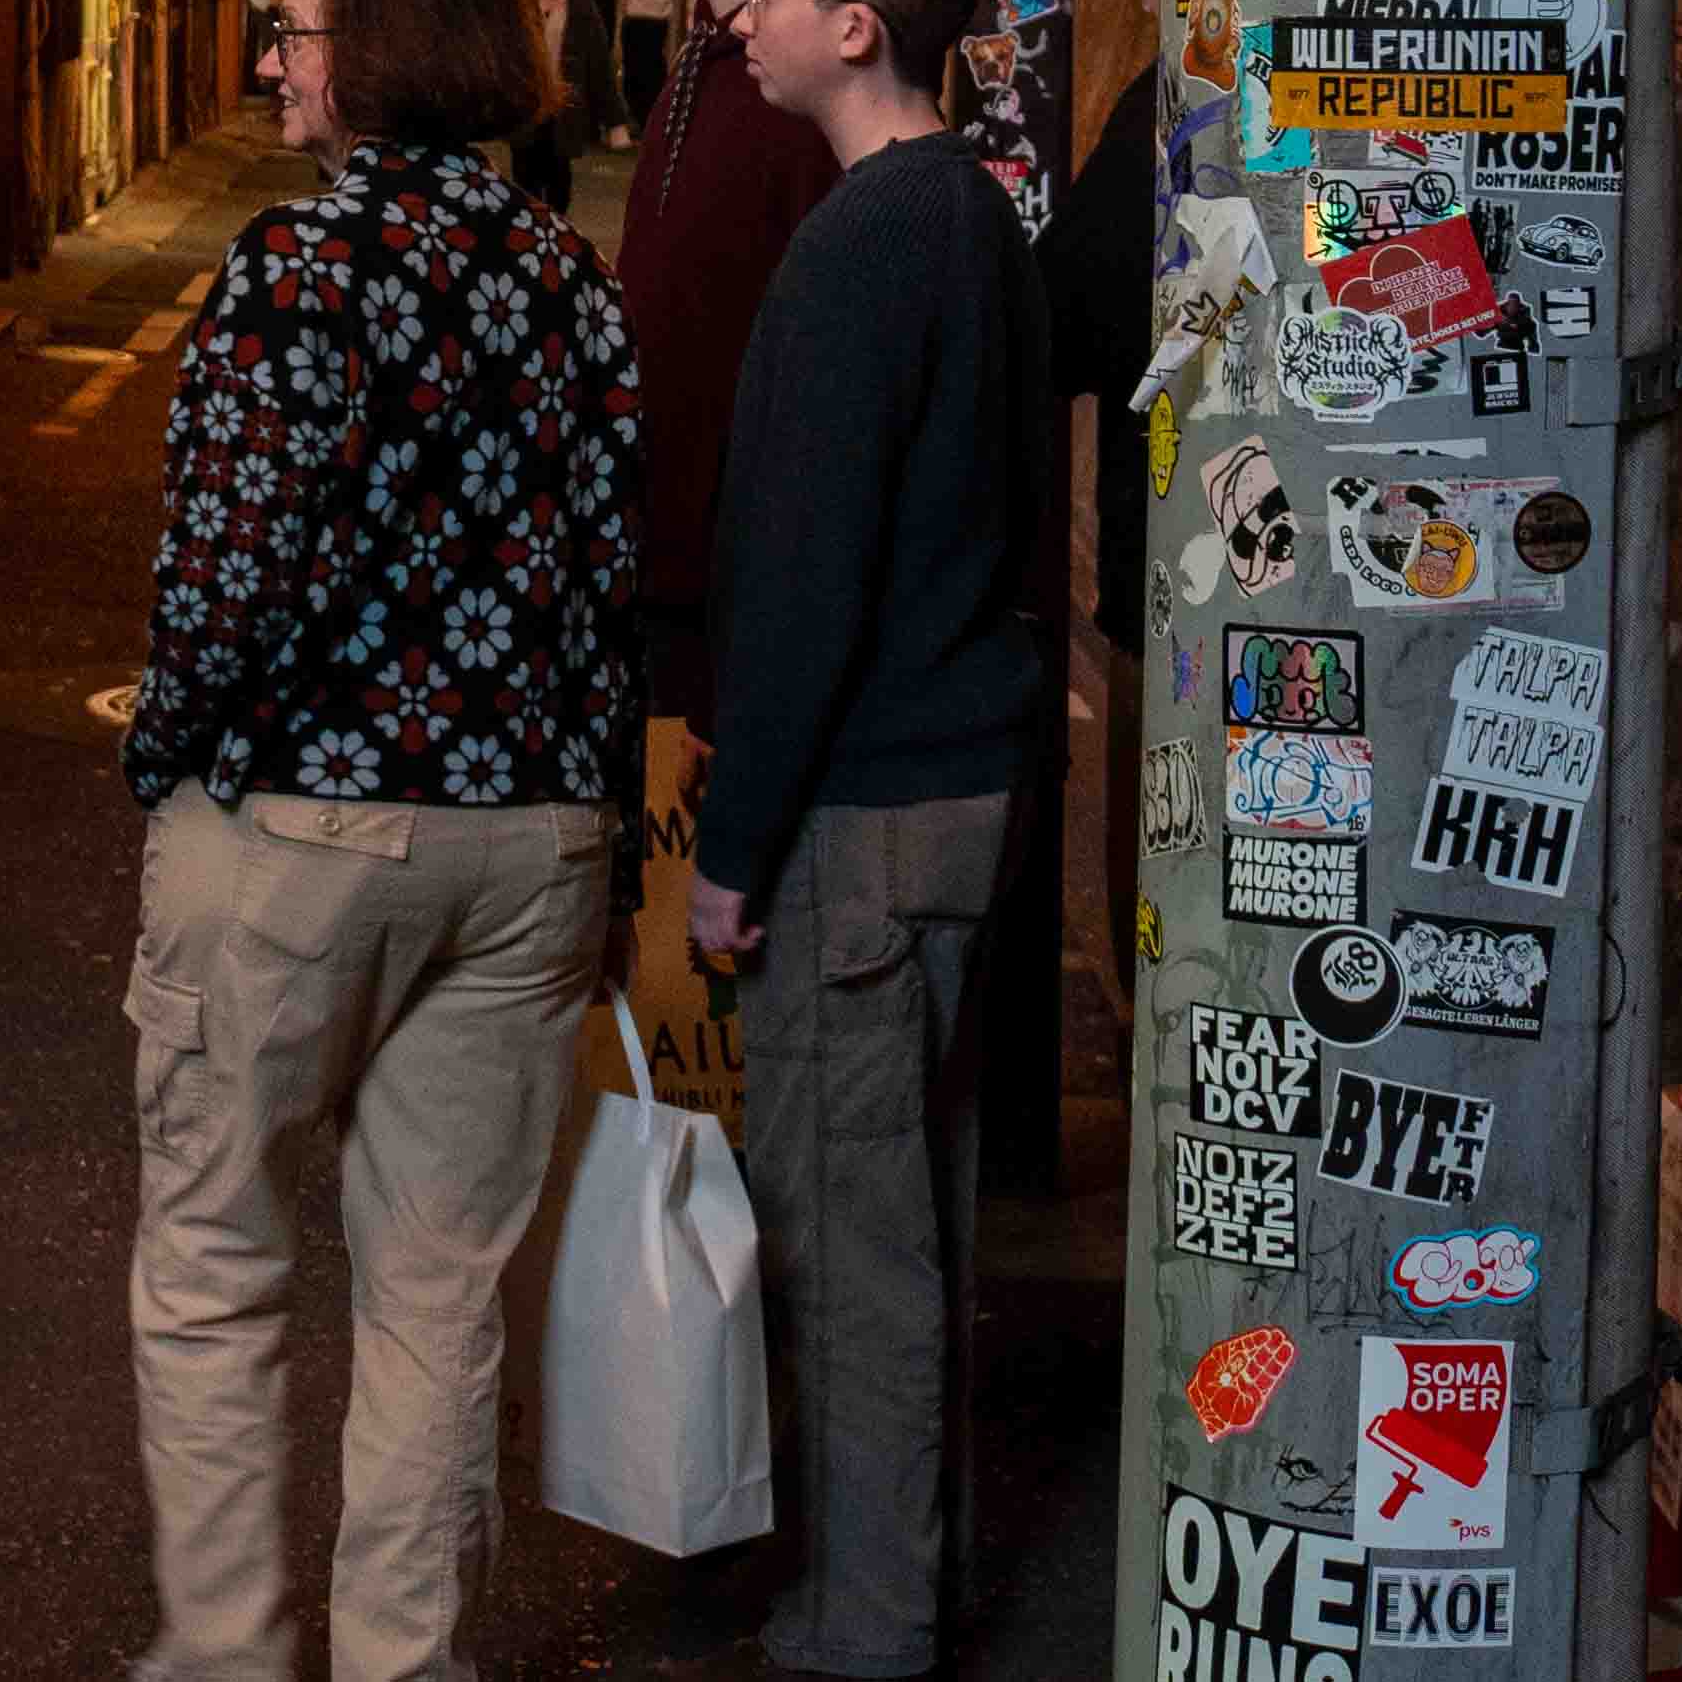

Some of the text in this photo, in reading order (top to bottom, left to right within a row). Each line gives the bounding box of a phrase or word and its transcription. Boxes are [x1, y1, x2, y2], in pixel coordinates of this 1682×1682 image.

[1292, 28, 1544, 71] WULFRUNIAN
[1318, 76, 1515, 118] REPUBLIC
[1475, 172, 1624, 193] DON'T MAKE PROMISES
[1308, 353, 1377, 381] Studio
[1474, 636, 1603, 711] TALPA
[1464, 706, 1597, 786] TALPA
[1230, 836, 1360, 871] MURONE
[1230, 861, 1360, 896] MURONE
[1230, 886, 1360, 922] MURONE
[1191, 1002, 1317, 1058] FEAR
[1457, 1011, 1495, 1026] LEBEN
[1495, 1013, 1540, 1031] LÄNGER
[1195, 1049, 1310, 1097] NOIZ
[1203, 1085, 1303, 1134] DCV
[1320, 1077, 1459, 1202] BYE
[1177, 1144, 1295, 1193] NOIZ
[1174, 1179, 1294, 1229] DEF2
[1174, 1215, 1296, 1268] ZEE
[1412, 1360, 1502, 1387] SOMA
[1411, 1387, 1500, 1412] OPER
[1458, 1522, 1491, 1541] pvs
[1164, 1494, 1359, 1651] OYE
[1378, 1574, 1510, 1639] EXOE
